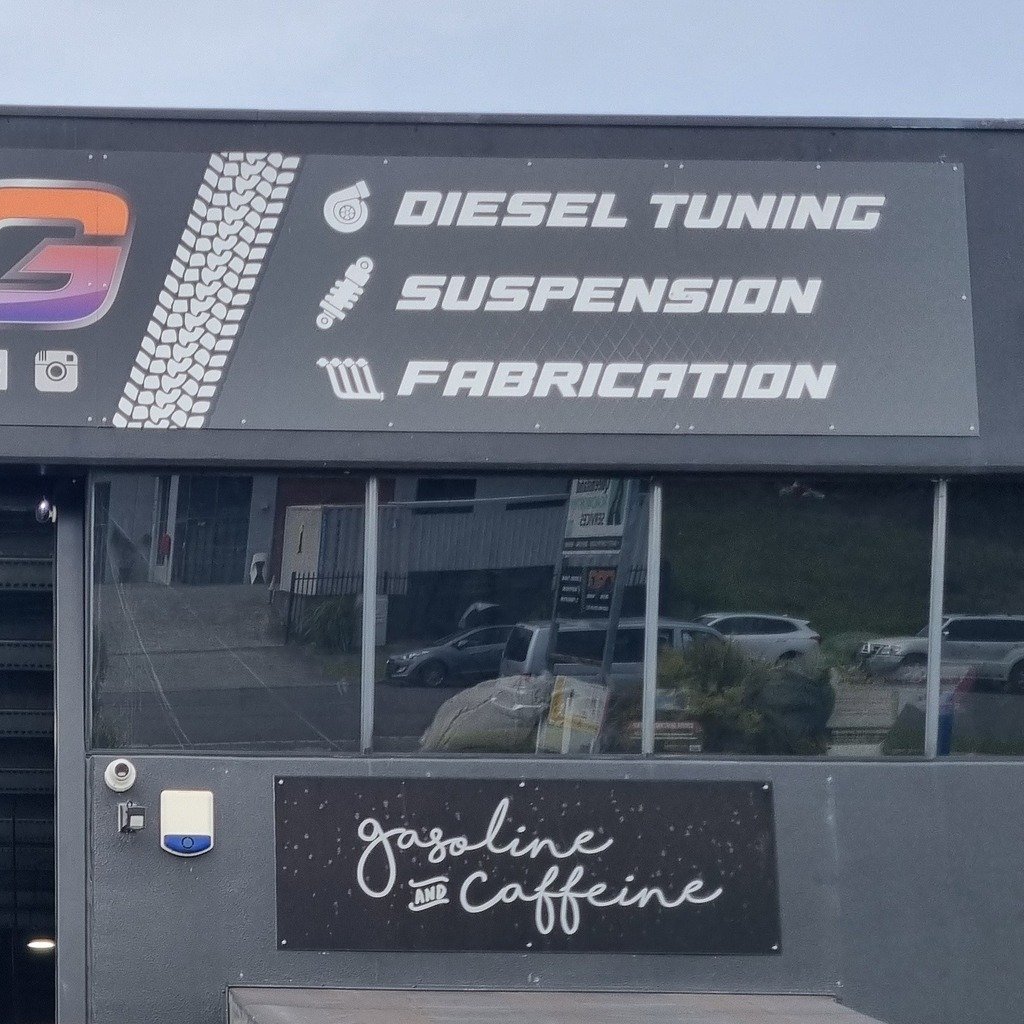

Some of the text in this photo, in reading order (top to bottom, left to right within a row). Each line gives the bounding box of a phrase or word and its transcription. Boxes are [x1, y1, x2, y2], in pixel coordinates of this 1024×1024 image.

[393, 190, 887, 231] DIESEL TUNING
[395, 274, 823, 314] SUSPENSION
[396, 359, 838, 400] FABRICATION
[356, 797, 614, 900] gasoline
[411, 880, 448, 906] AND
